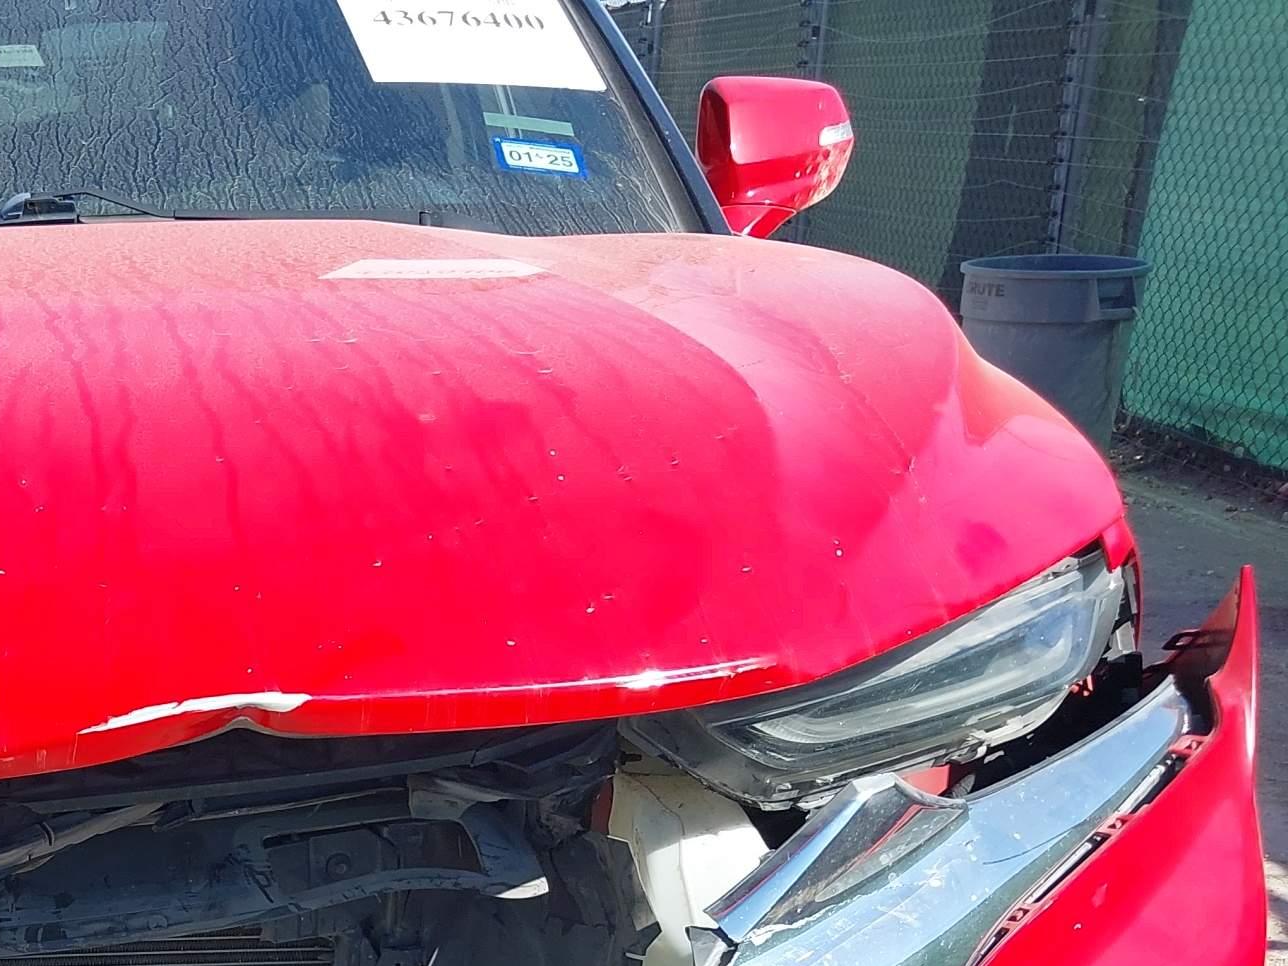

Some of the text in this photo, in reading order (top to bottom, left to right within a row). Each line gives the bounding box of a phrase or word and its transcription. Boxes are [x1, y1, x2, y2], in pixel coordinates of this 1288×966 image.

[373, 10, 545, 31] 43676400
[509, 149, 533, 163] 01
[546, 153, 574, 168] 25
[966, 281, 1005, 297] RUTE
